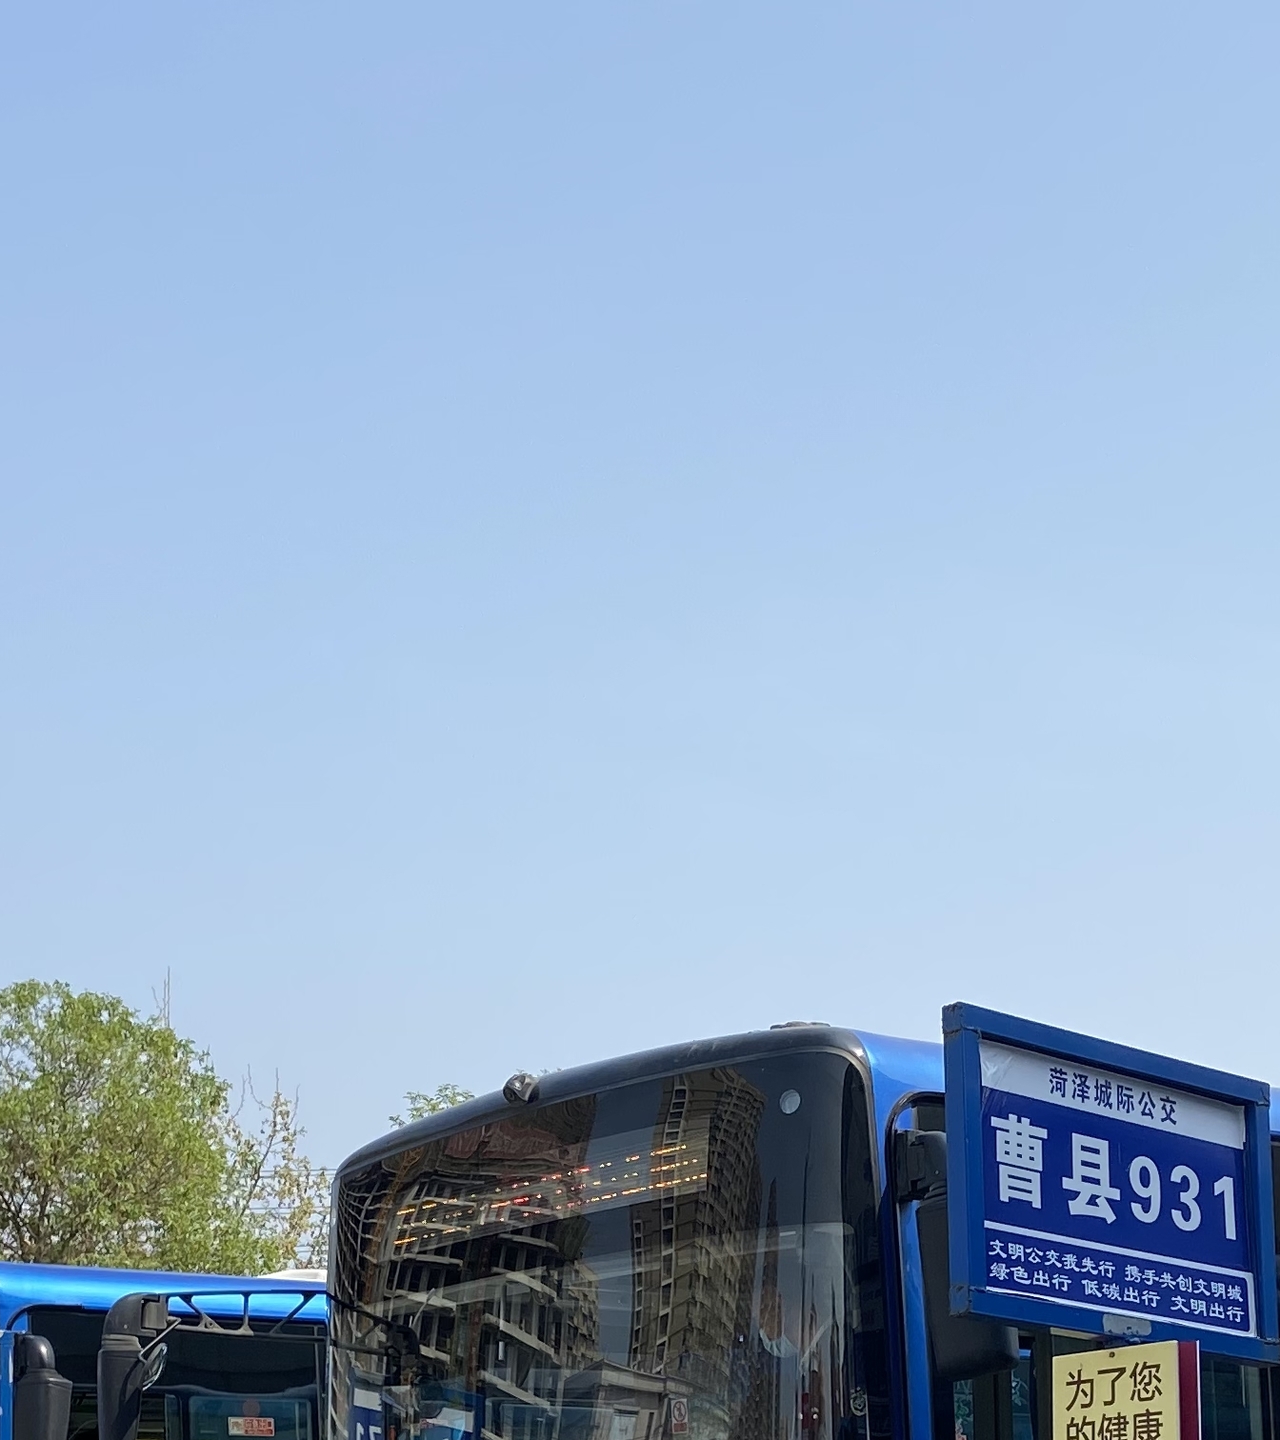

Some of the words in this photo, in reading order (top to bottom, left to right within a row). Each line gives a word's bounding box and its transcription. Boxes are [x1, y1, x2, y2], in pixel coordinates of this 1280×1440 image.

[1048, 1066, 1178, 1126] 菏泽城际公交
[990, 1112, 1237, 1241] 曹县931
[988, 1239, 1116, 1279] 文明公交我先行
[1124, 1264, 1244, 1303] 携手共创文明城
[988, 1261, 1072, 1292] 绿色出行
[1080, 1278, 1161, 1308] 低碳出行
[1170, 1296, 1245, 1324] 文明出行
[1064, 1361, 1163, 1413] 为了您
